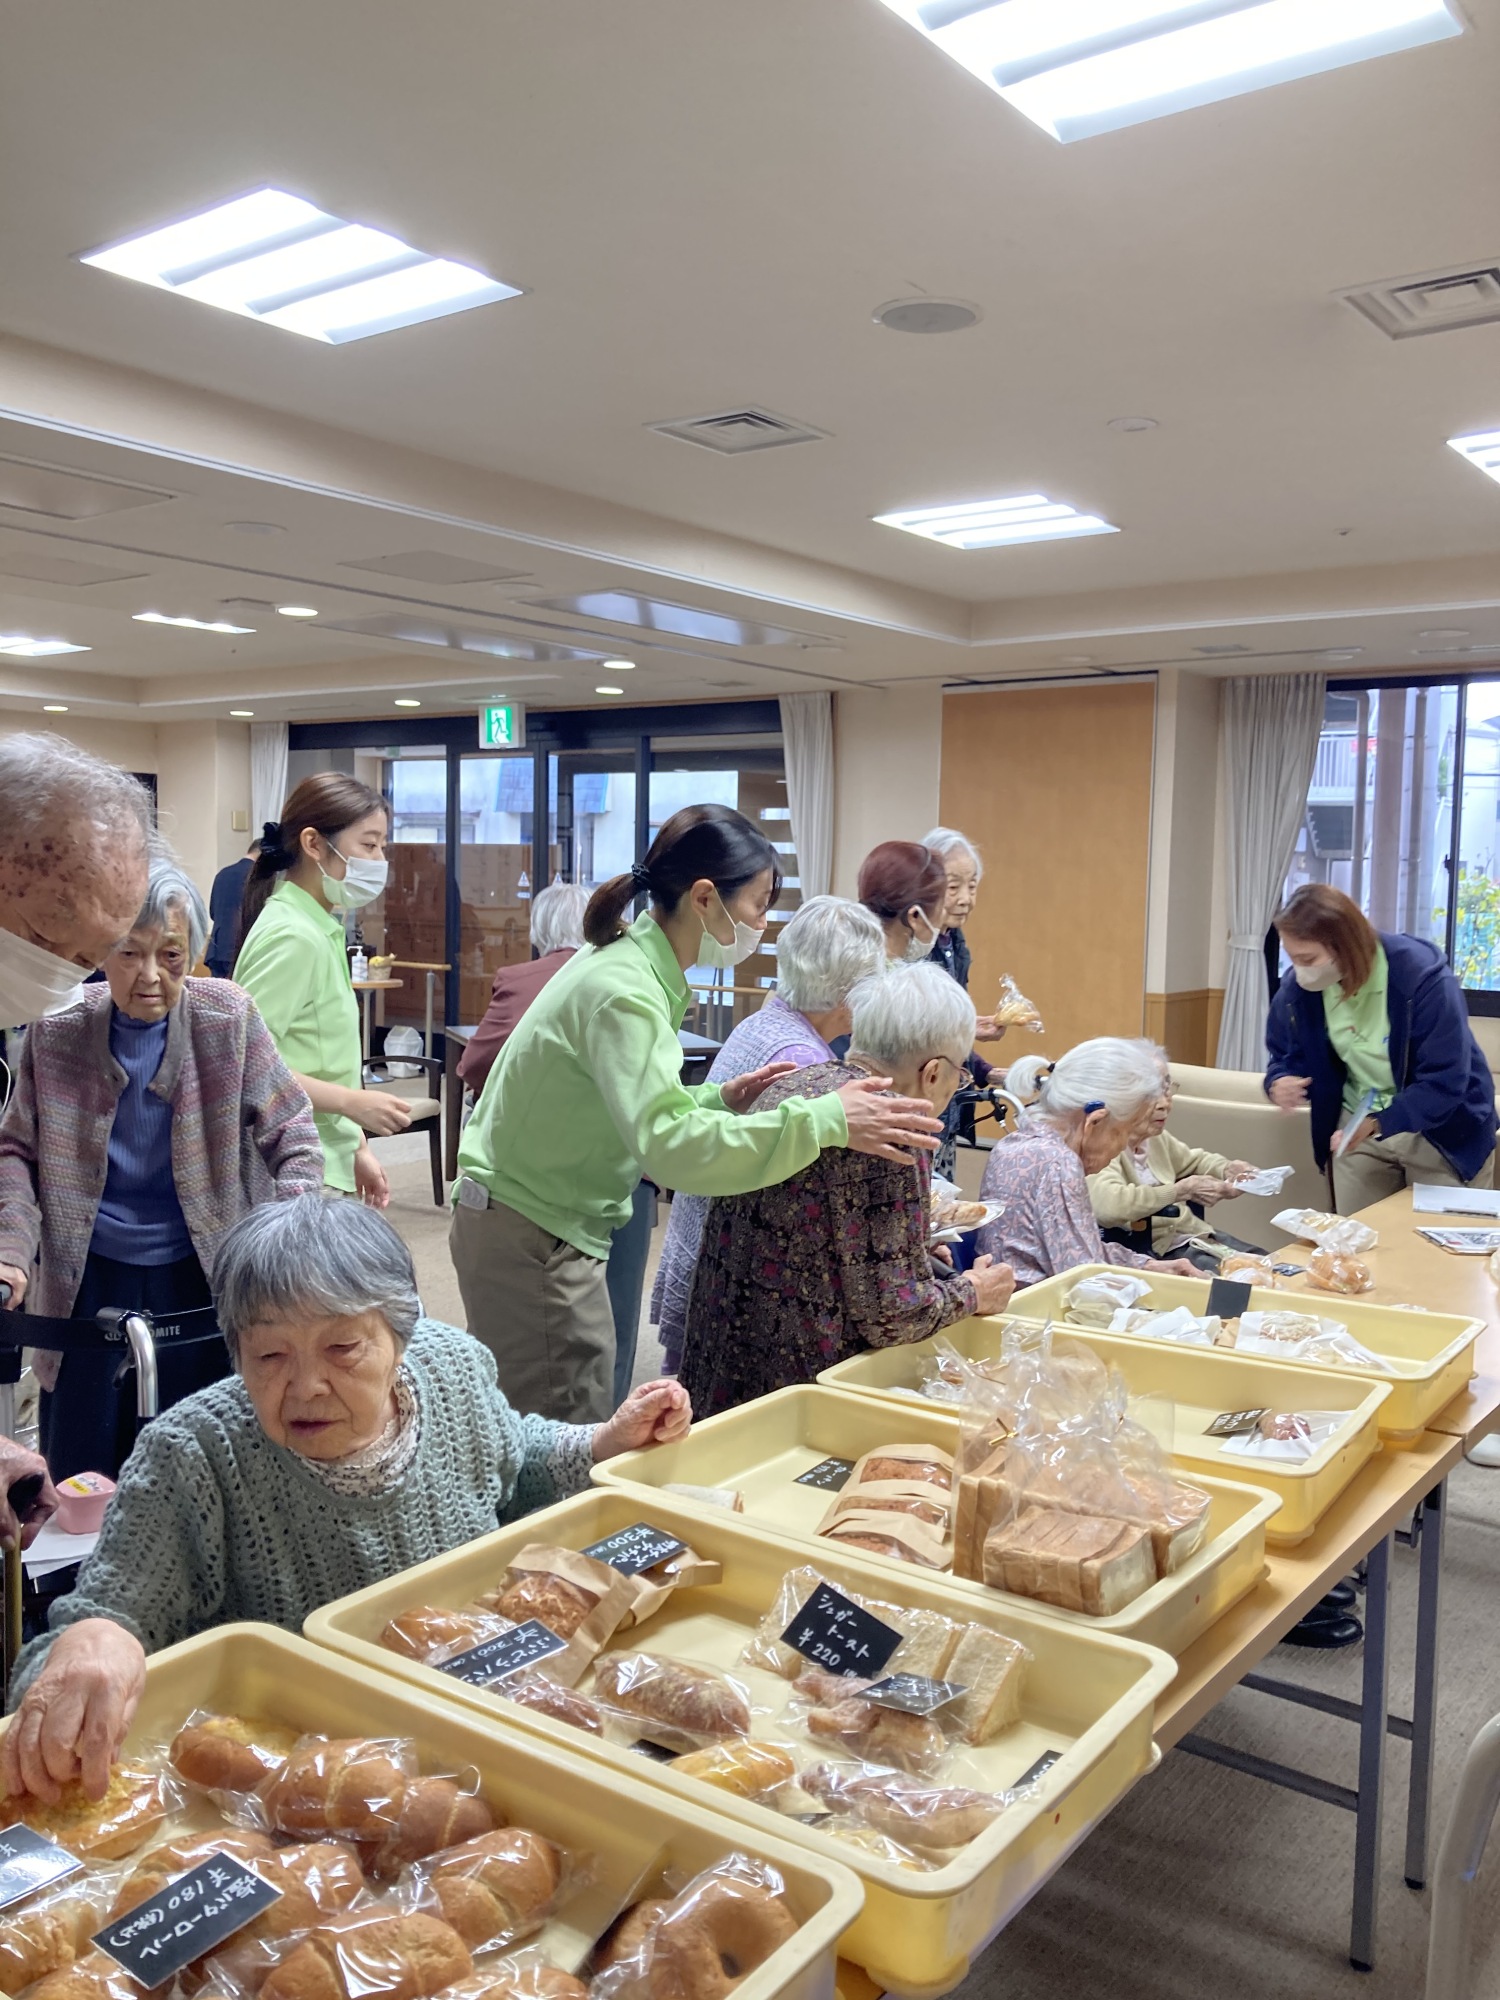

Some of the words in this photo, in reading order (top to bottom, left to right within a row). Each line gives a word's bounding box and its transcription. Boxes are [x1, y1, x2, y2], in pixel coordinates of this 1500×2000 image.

[607, 1527, 655, 1549] ¥300
[818, 1593, 858, 1627] シュガー
[826, 1624, 870, 1658] トースト
[139, 1875, 258, 1959] 塩バターロール
